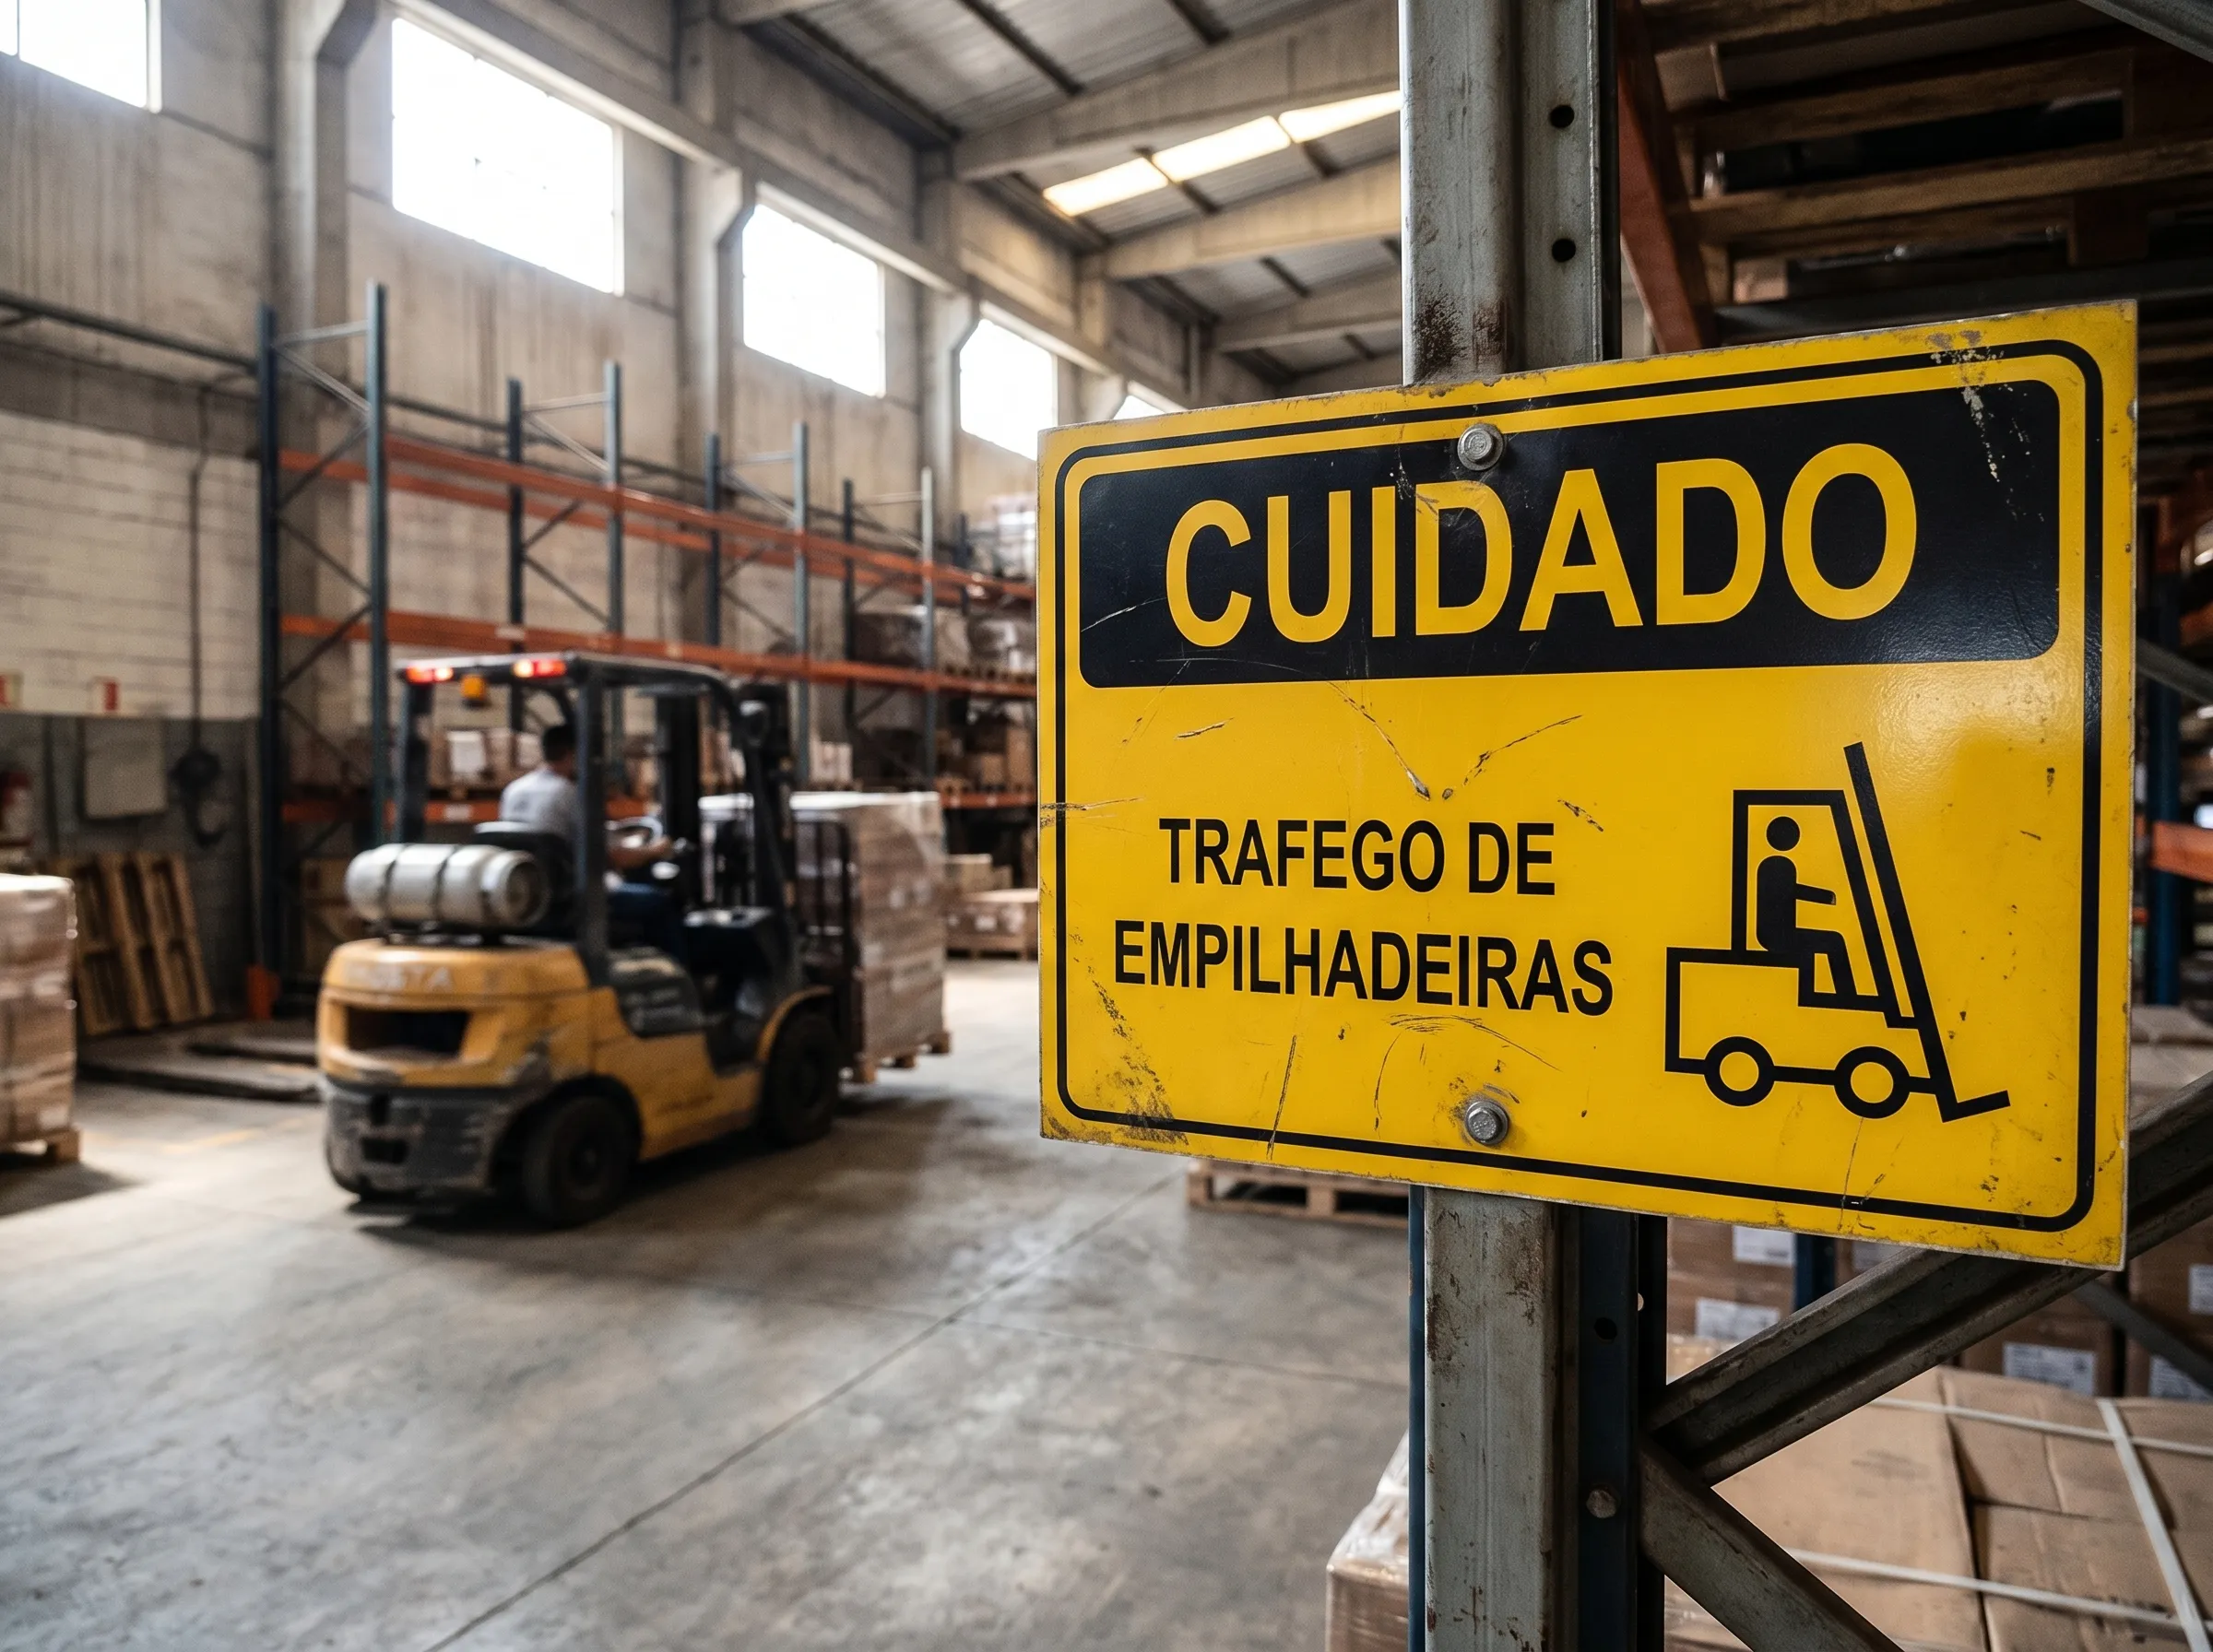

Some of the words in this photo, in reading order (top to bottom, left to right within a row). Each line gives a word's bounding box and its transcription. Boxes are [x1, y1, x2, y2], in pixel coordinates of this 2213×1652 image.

[1166, 443, 1917, 647] CUIDADO
[1160, 818, 1445, 893] TRAFEGO
[1468, 821, 1556, 896] DE
[1115, 919, 1614, 1017] EMPILHADEIRAS
